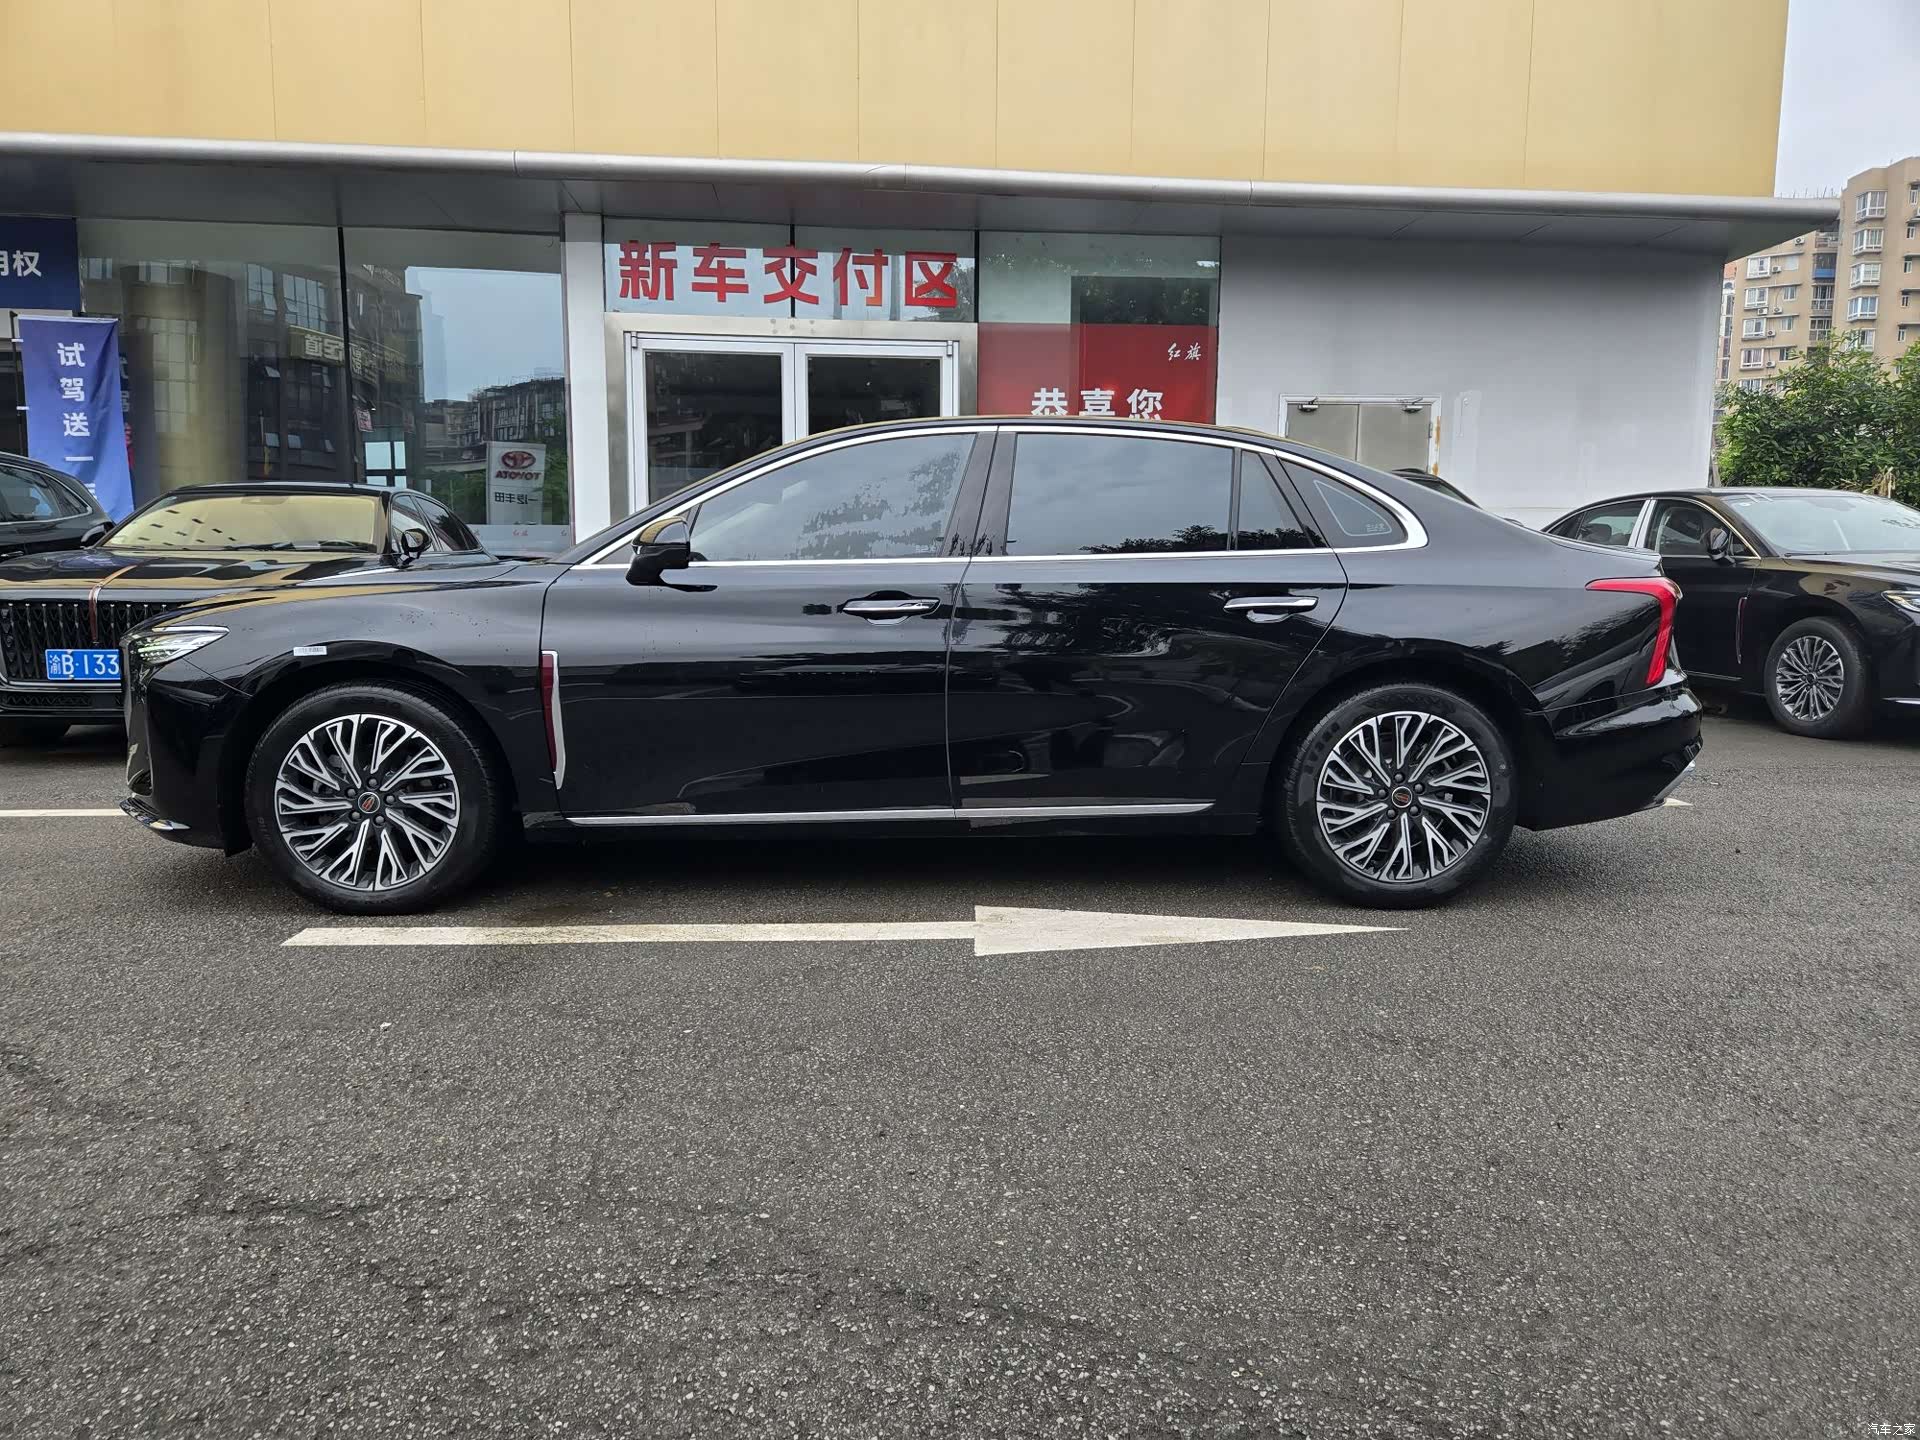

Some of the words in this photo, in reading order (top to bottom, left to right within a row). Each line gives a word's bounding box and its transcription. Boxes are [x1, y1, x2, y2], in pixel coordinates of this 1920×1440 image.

[618, 240, 958, 307] 新车交付区
[1167, 342, 1202, 361] 红旗
[56, 342, 98, 500] 试驾送一
[1031, 387, 1164, 420] 恭喜您
